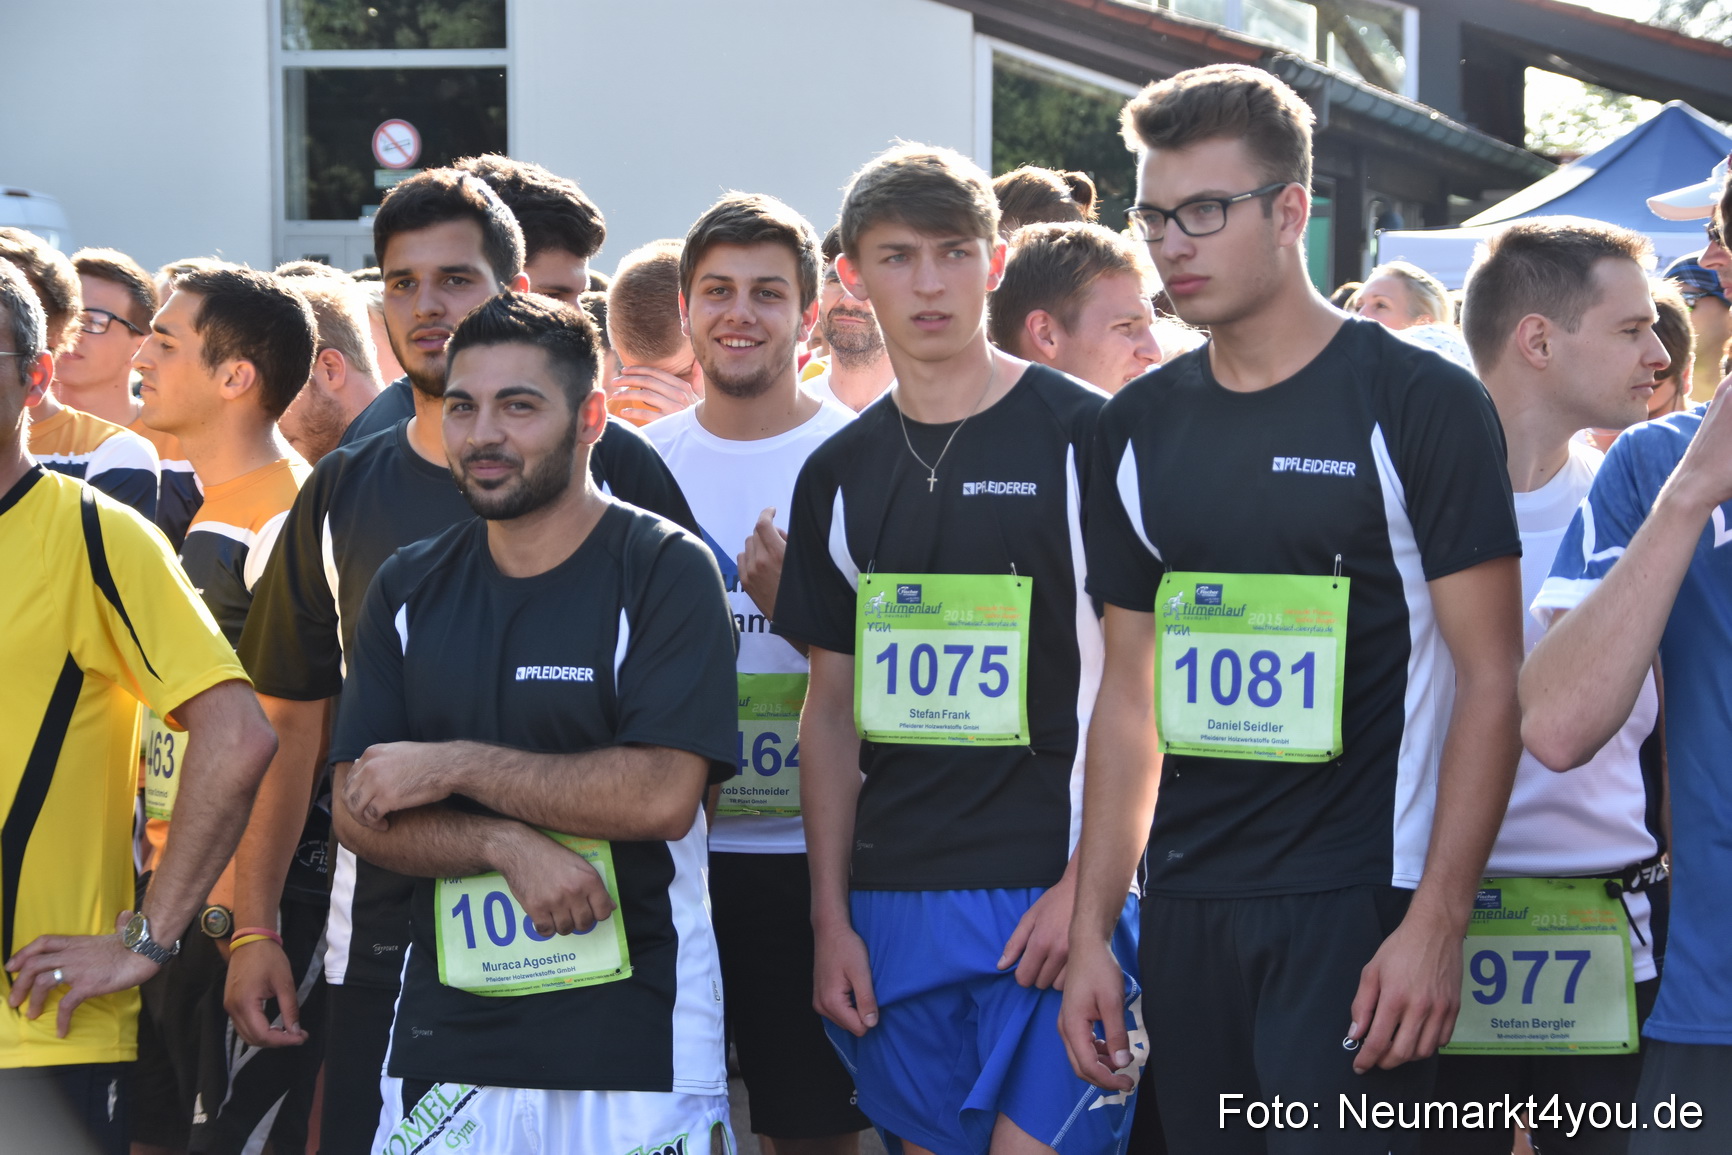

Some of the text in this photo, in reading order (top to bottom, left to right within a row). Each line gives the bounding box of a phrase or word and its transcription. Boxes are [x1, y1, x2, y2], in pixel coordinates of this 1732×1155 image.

[1284, 457, 1356, 476] PFLEIDERER
[884, 601, 943, 614] firmenlauf
[1183, 603, 1247, 617] firmenlauf
[943, 610, 975, 621] 2015
[1247, 613, 1284, 625] 2015
[525, 666, 594, 681] PFLEIDERER
[876, 642, 1009, 698] 1075
[1175, 647, 1315, 709] 1081
[909, 708, 971, 720] Stefan Frank
[1207, 719, 1284, 733] Daniel Seidler
[740, 786, 790, 796] Schneider
[1531, 914, 1568, 926] 2015
[482, 952, 577, 973] Muraca Agostino
[485, 966, 577, 983] Pfleiderer Holzwerkstoffe GmbH
[1469, 949, 1591, 1005] 977
[1490, 1018, 1576, 1031] Stefan Bergler
[445, 1119, 477, 1149] Gym
